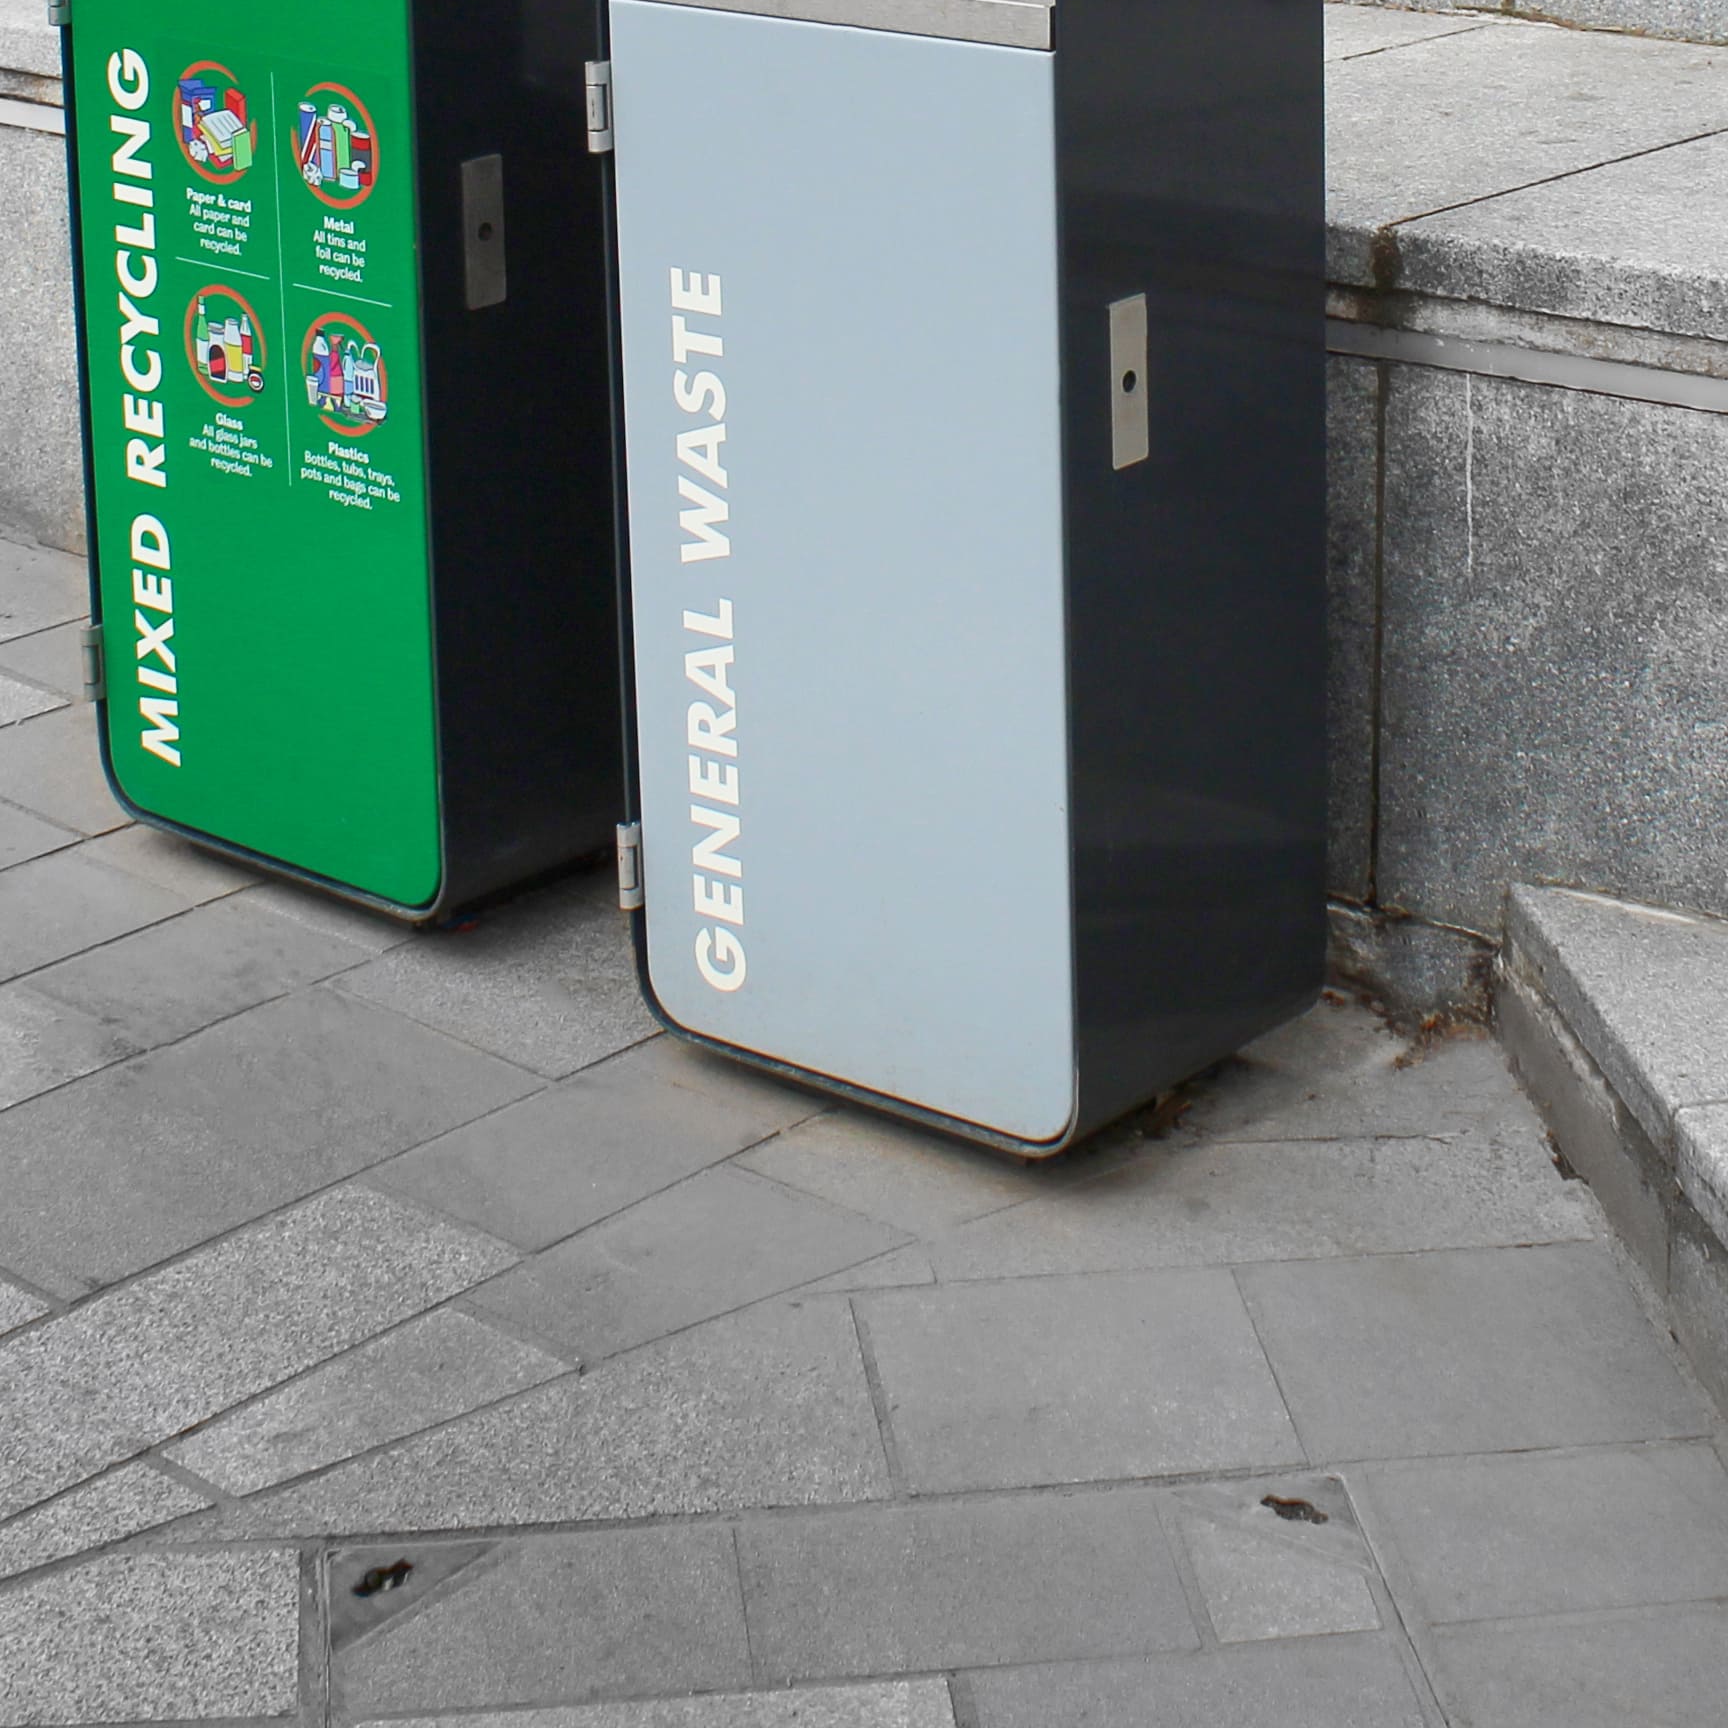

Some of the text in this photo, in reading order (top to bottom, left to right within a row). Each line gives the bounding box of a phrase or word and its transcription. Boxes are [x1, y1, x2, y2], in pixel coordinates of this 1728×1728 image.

[186, 187, 252, 213] Paper & card
[189, 204, 250, 227] All paper and
[324, 216, 354, 234] Metal
[193, 222, 248, 242] card can be
[313, 230, 366, 252] All tins and
[200, 238, 242, 256] recycled.
[316, 245, 366, 268] foil can be
[319, 264, 363, 283] recycled.
[107, 47, 182, 768] MIXED RECYCLING
[215, 413, 243, 431] Glass
[202, 424, 258, 449] All glass jars
[189, 437, 273, 468] and bottles can be
[304, 450, 341, 472] Bottles,
[328, 441, 369, 464] Plastics
[211, 458, 253, 477] recycled.
[301, 468, 401, 502] pots and bags can be
[329, 490, 373, 510] recycled.
[670, 265, 747, 993] GENERAL WASTE
